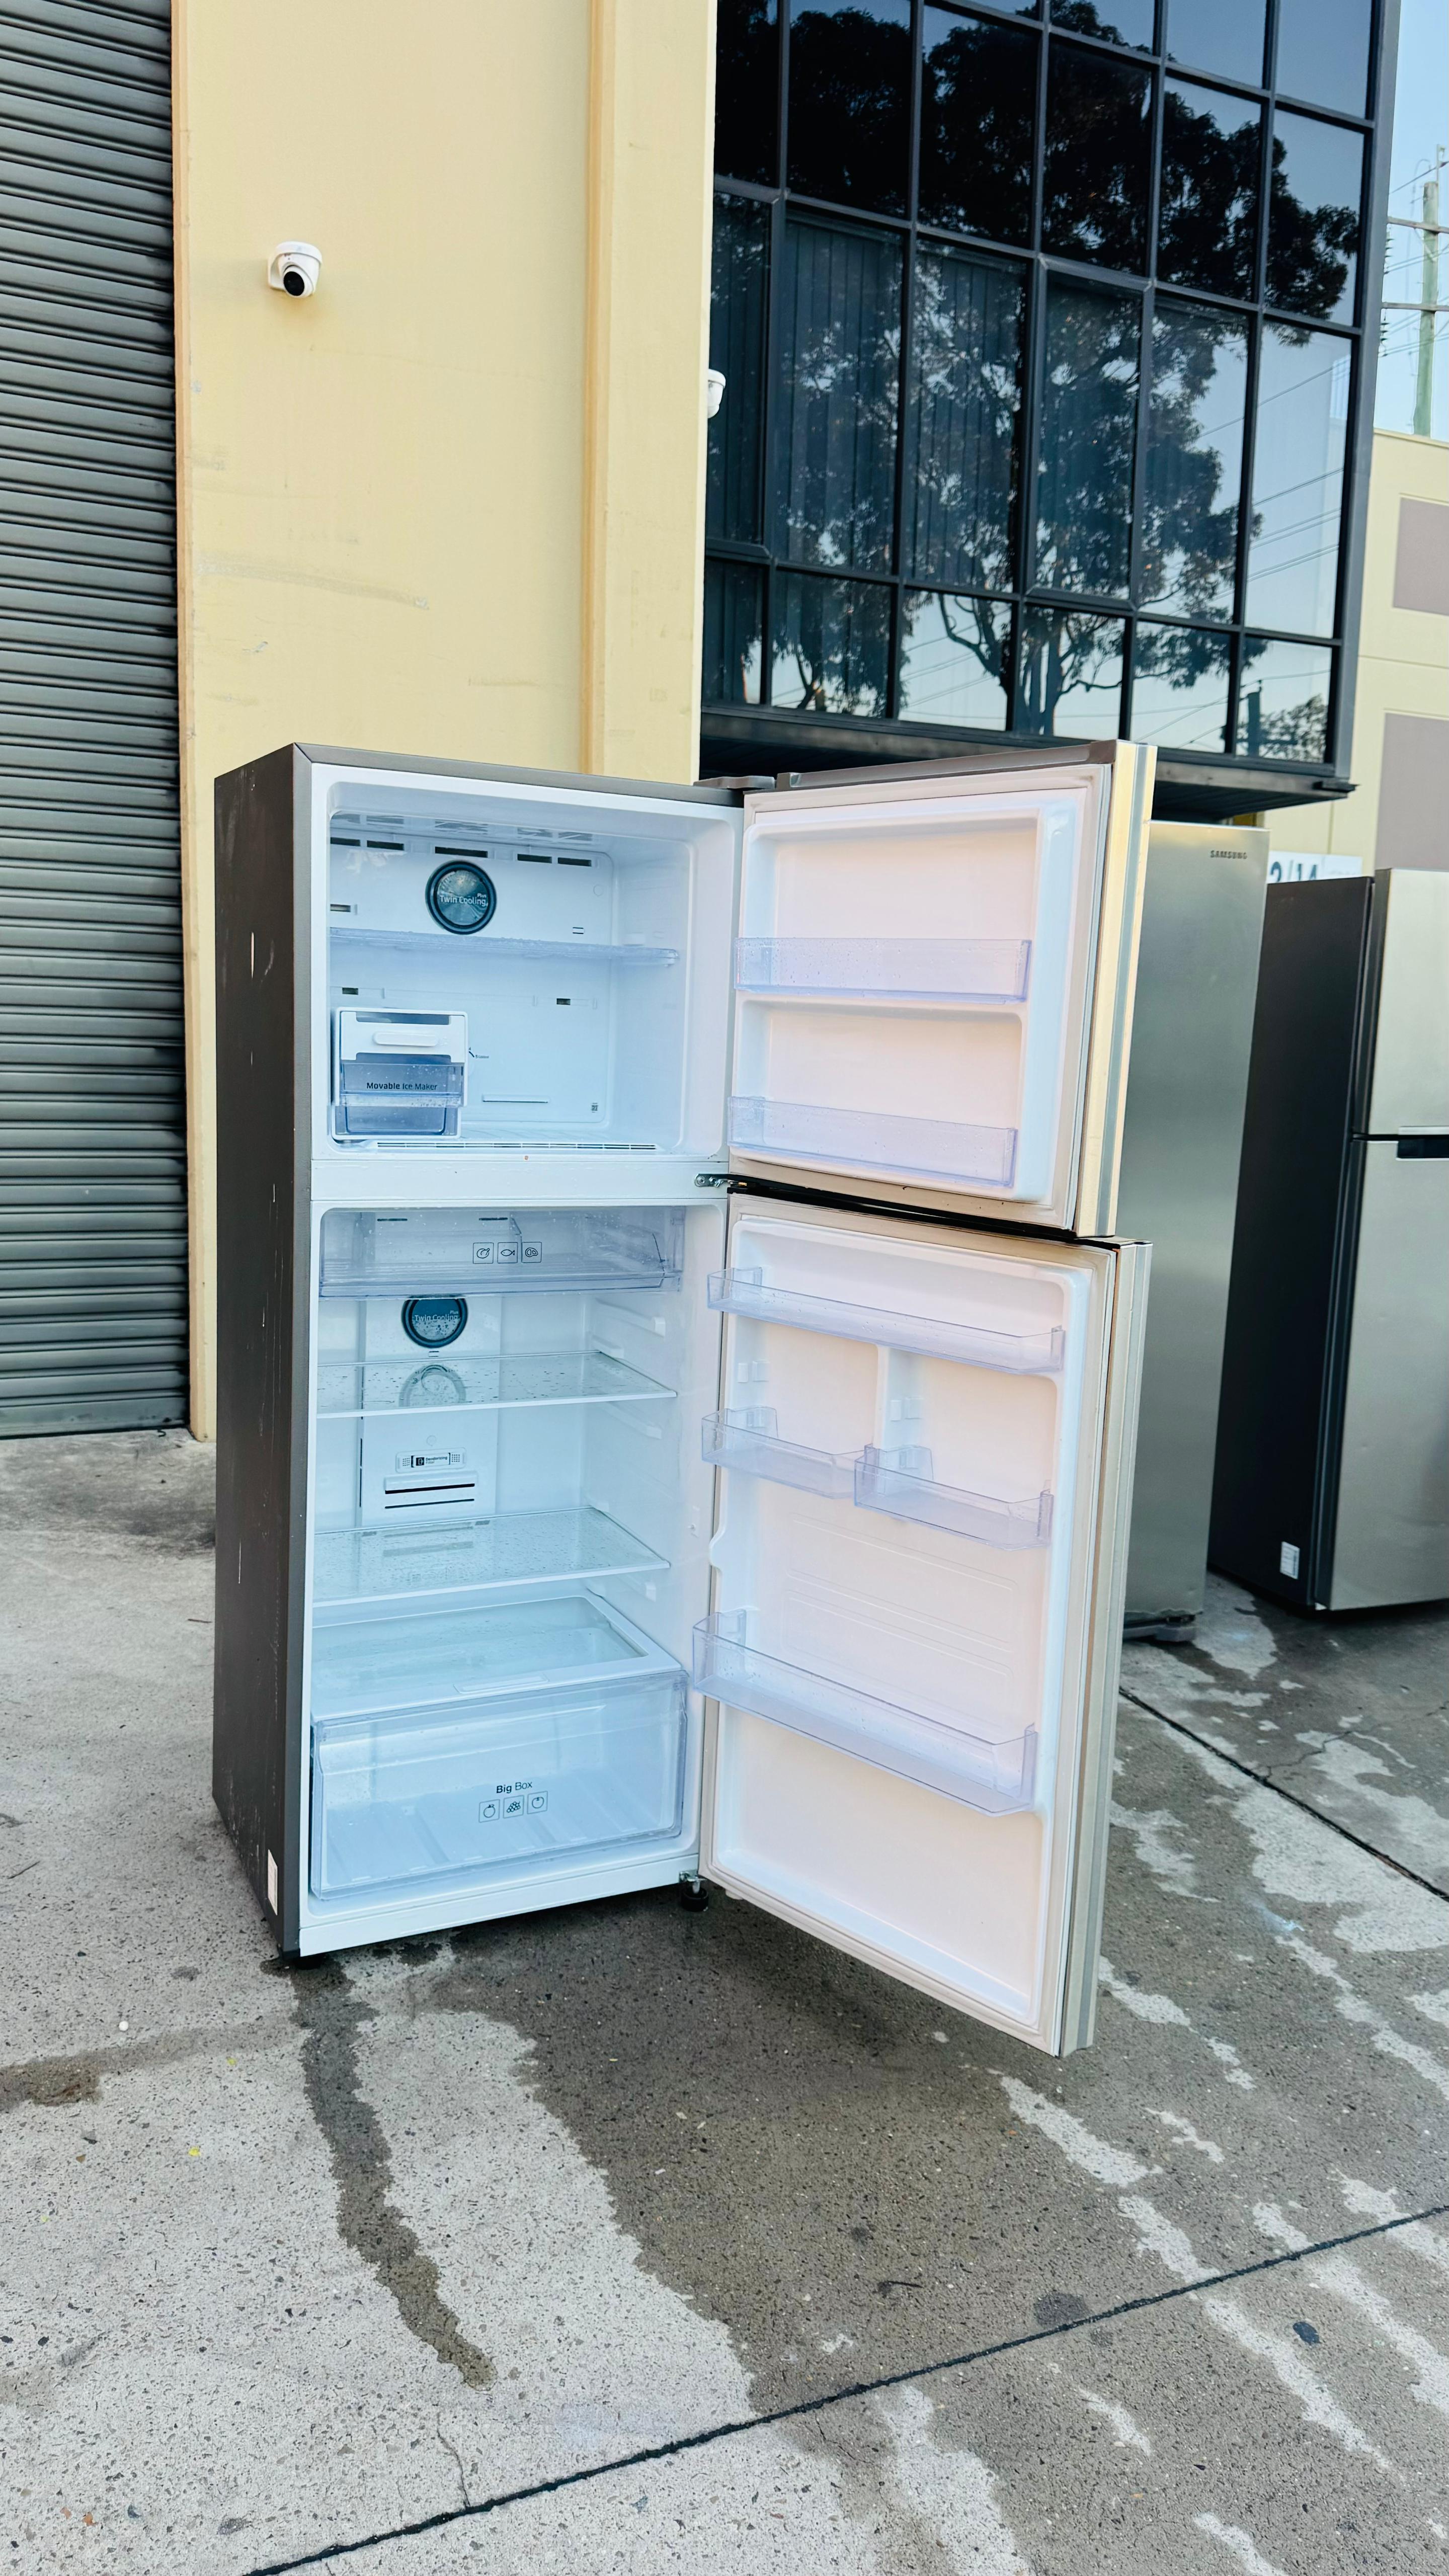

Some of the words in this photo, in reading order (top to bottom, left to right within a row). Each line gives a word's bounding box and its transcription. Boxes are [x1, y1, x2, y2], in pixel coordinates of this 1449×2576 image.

[1210, 850, 1247, 859] SAMSUNG
[440, 895, 457, 903] Twin
[459, 896, 486, 907] Cooling
[496, 1785, 512, 1794] Big
[515, 1782, 532, 1791] Box
